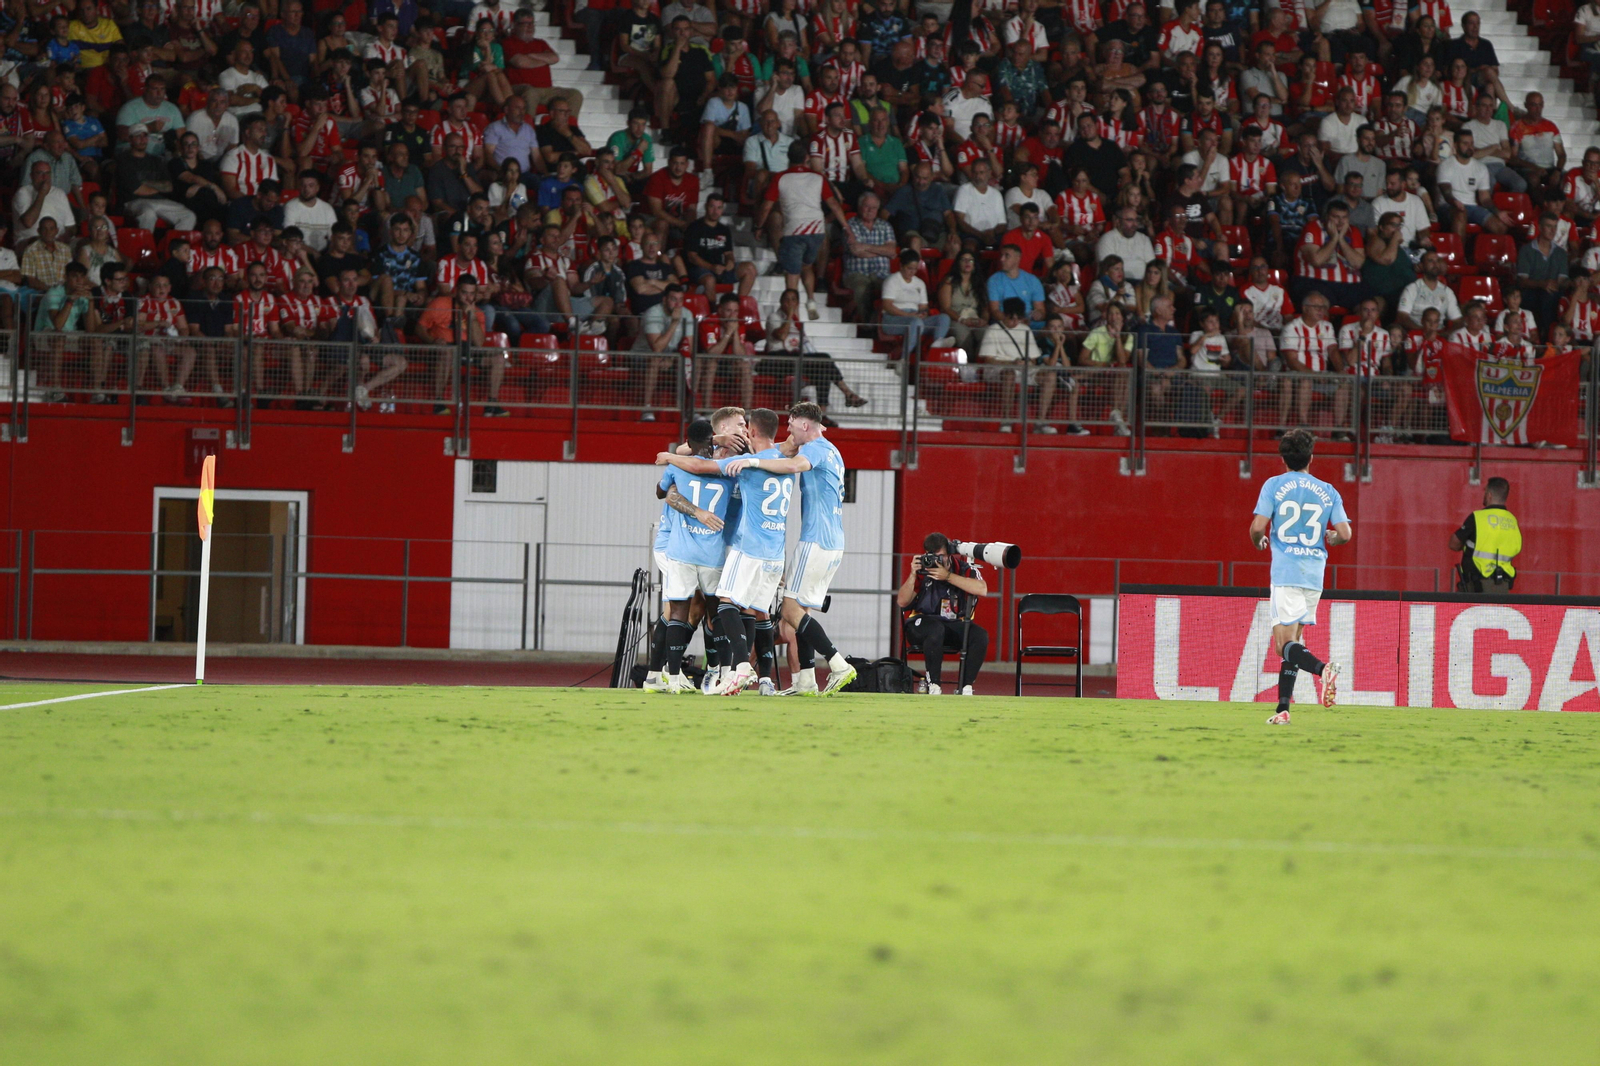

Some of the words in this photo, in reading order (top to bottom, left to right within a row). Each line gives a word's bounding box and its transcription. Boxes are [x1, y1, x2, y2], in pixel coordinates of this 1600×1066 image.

[1484, 384, 1529, 396] ALMERIA
[1486, 370, 1500, 379] U
[1519, 370, 1532, 380] D
[688, 480, 724, 514] 17
[761, 477, 794, 517] 28
[1275, 480, 1298, 502] MANU
[1277, 500, 1323, 546] 23
[1153, 597, 1600, 711] LALIGA
